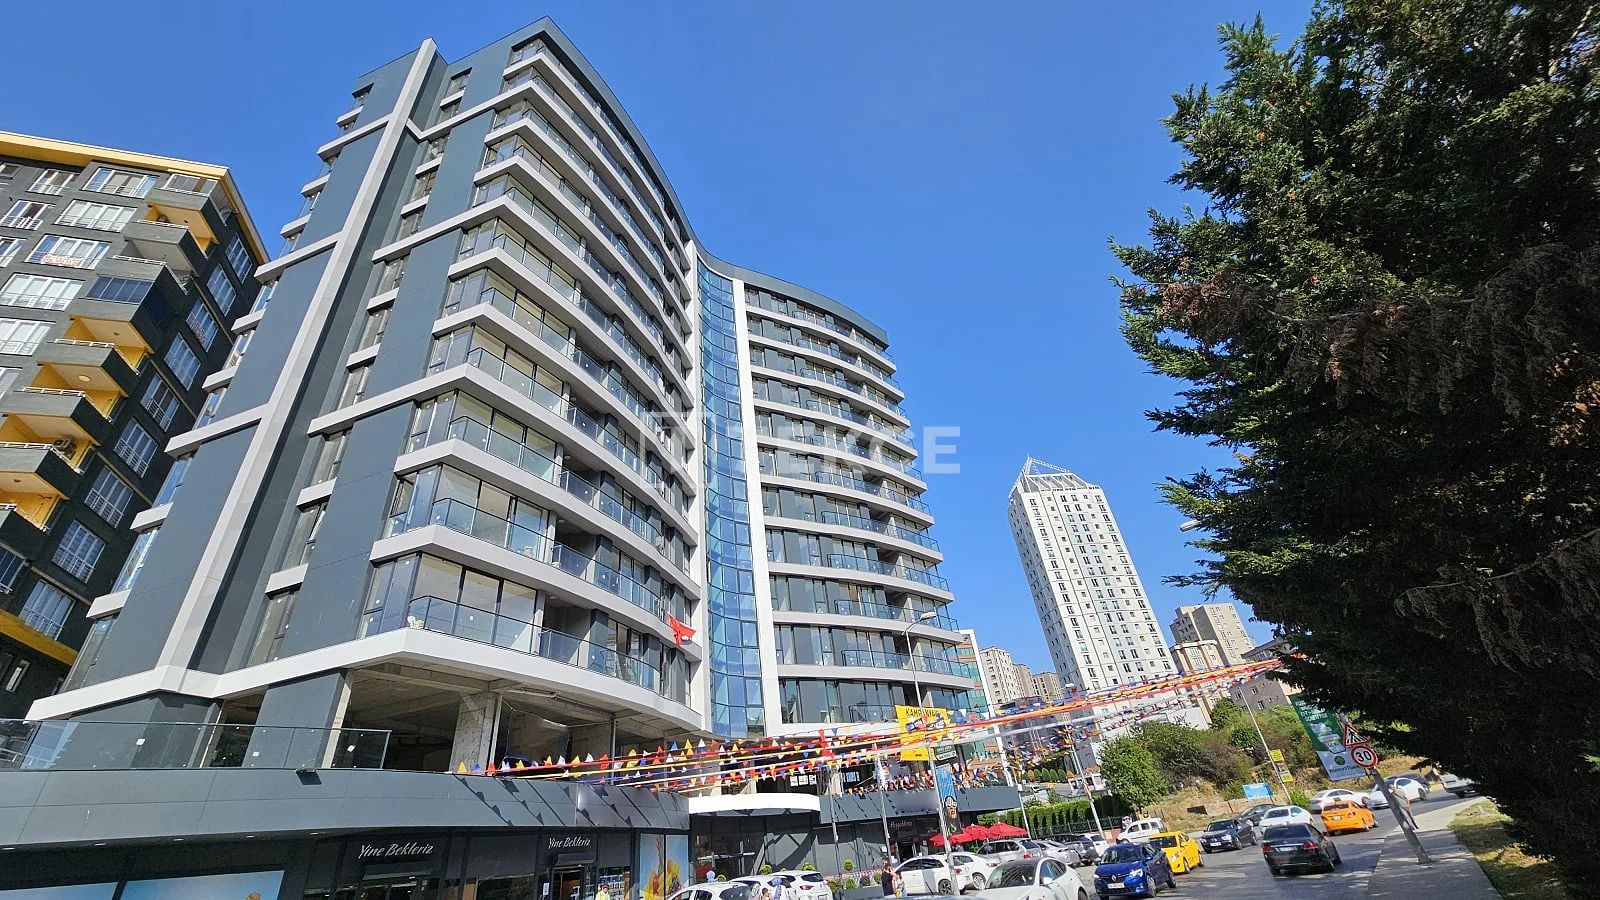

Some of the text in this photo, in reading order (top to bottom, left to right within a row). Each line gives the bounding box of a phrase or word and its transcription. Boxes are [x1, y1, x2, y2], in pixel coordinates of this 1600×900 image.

[1355, 750, 1372, 762] 30
[548, 837, 563, 849] Yine
[358, 842, 434, 859] Yine Bekleriz
